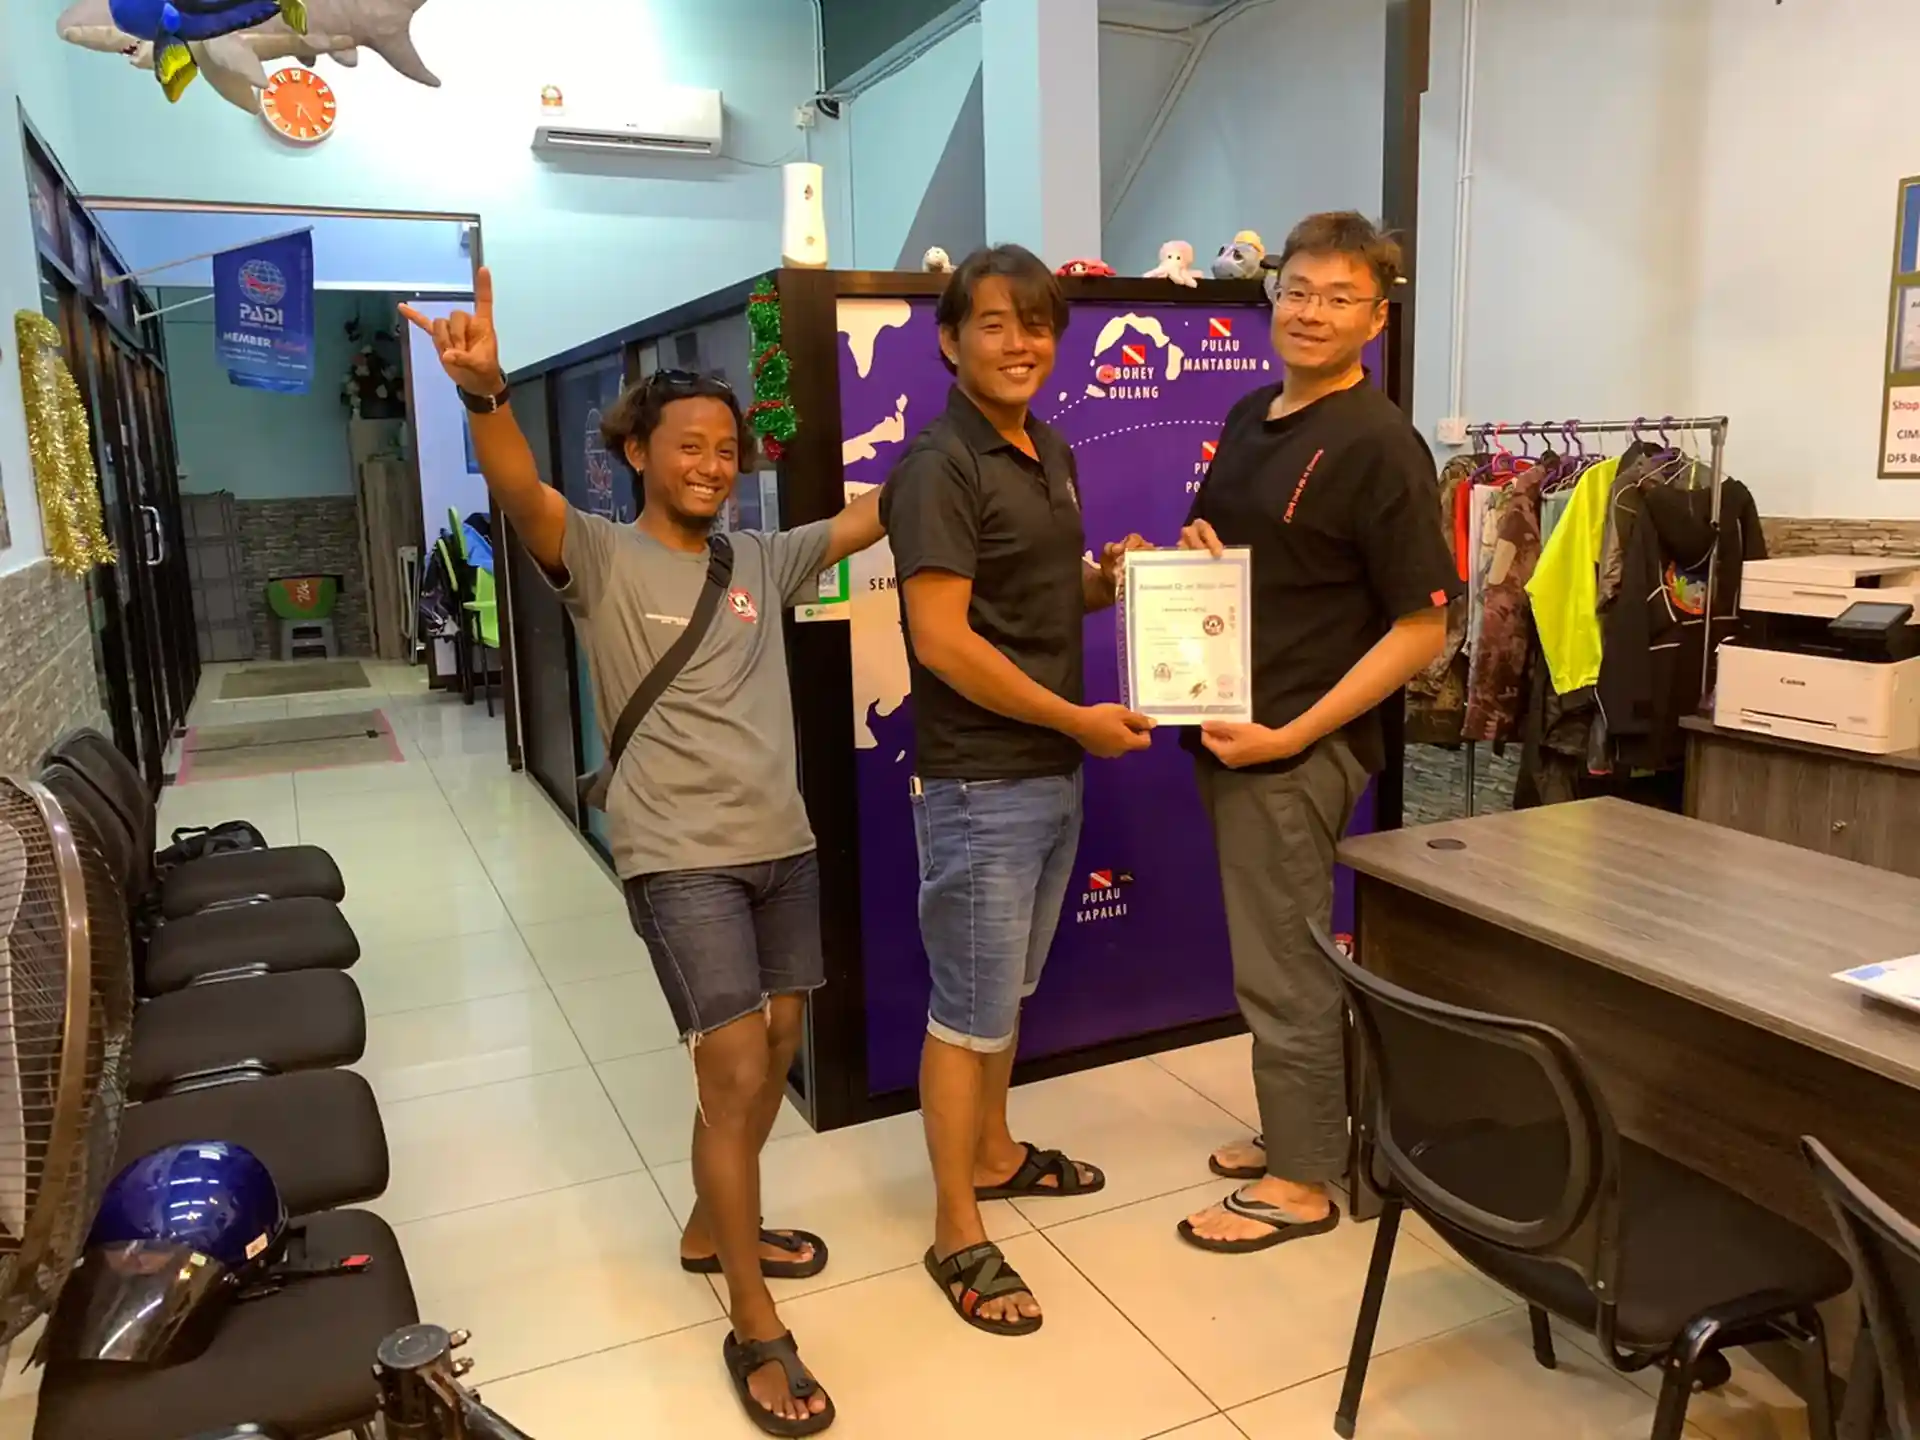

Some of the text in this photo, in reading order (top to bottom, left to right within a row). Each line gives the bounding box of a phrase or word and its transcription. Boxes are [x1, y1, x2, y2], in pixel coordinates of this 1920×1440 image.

[240, 302, 283, 325] PADI
[223, 331, 271, 348] MEMBER
[1201, 339, 1240, 352] PULAU
[1183, 357, 1257, 371] MANTABUAN
[1114, 366, 1154, 380] BOHEY
[1109, 386, 1160, 400] DULANG
[1892, 400, 1920, 412] Shop
[1779, 676, 1806, 687] Canon
[1082, 887, 1121, 905] PULAU
[1076, 903, 1127, 924] KAPALAI
